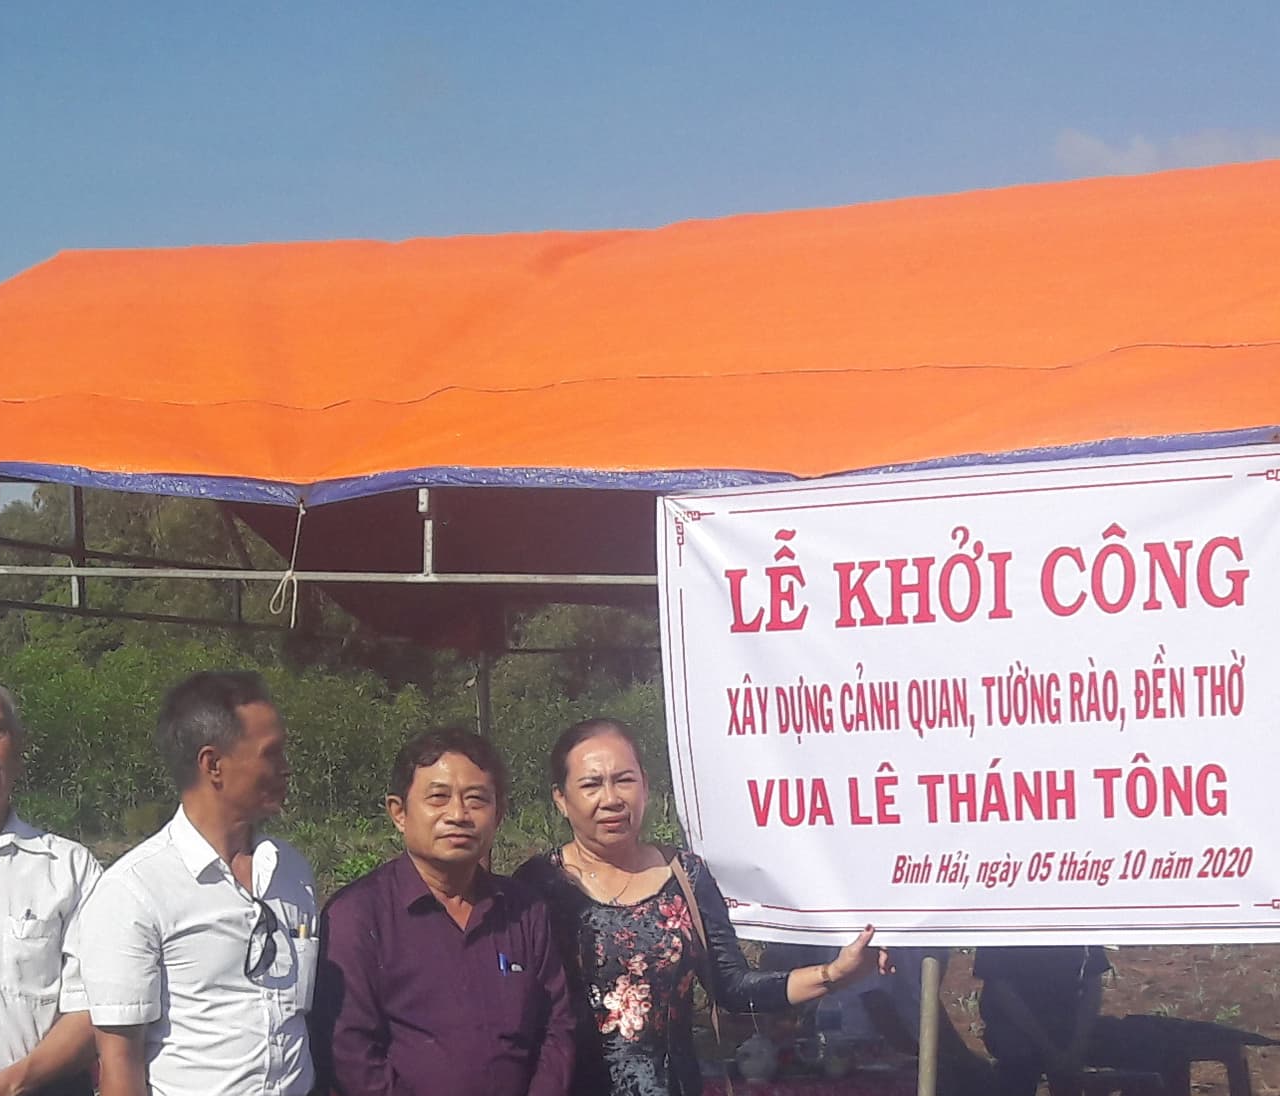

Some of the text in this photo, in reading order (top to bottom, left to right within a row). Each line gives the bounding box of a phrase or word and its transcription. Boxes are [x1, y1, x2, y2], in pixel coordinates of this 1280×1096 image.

[724, 523, 1251, 634] LỄ KHỞI CÔNG
[726, 644, 1246, 744] XÂY DỰNG CẢNH QUAN, TƯỜNG RÀO, ĐỀN THỜ
[747, 752, 1229, 828] VUA LÊ THÁNH TÔNG
[891, 846, 1254, 890] Bình Hải, ngày 05 tháng 10 năm 2020
